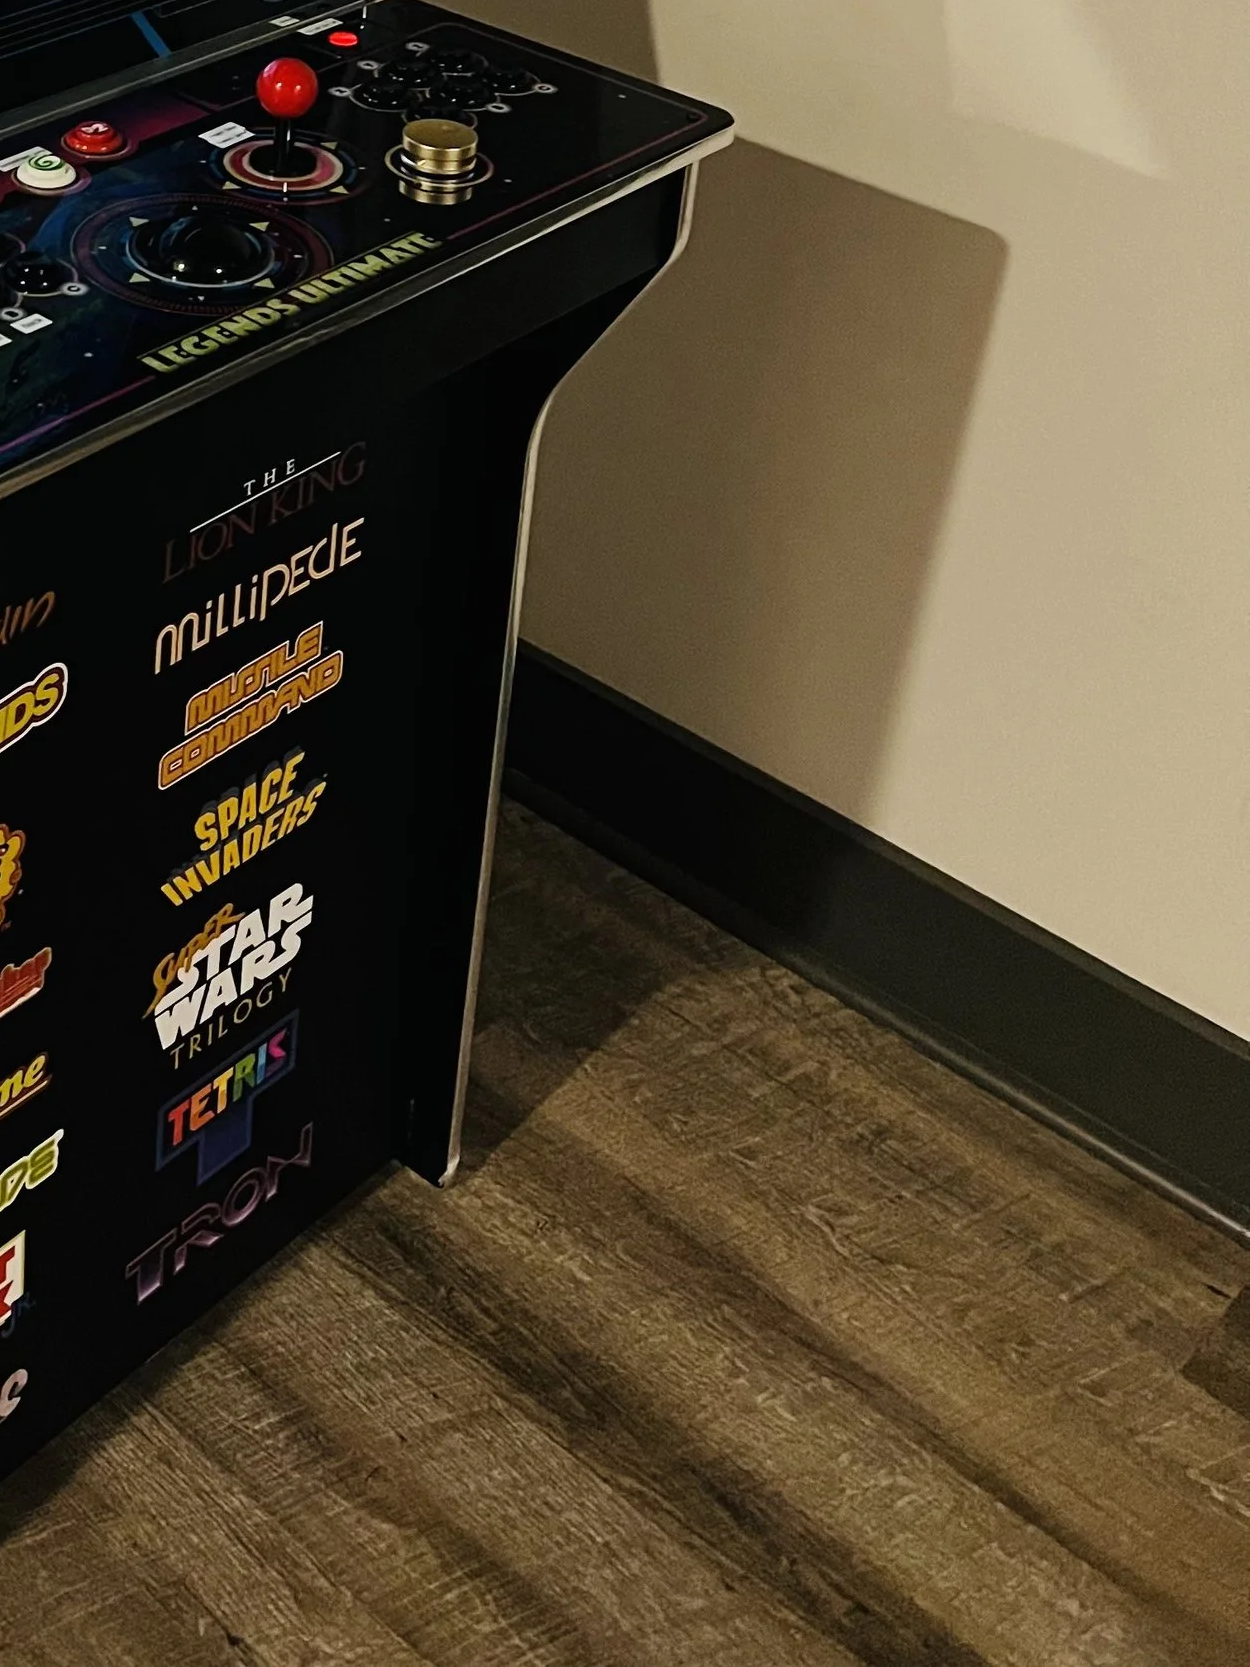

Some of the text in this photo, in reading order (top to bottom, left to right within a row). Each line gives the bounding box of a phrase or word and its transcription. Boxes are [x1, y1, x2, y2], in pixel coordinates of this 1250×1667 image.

[141, 232, 443, 373] LEGENDS ULTIMATE
[162, 441, 368, 584] LION KING
[243, 458, 296, 497] THE
[158, 650, 343, 790] COMMAND
[186, 621, 323, 734] MISSILE
[161, 781, 327, 906] INVADERS
[194, 749, 304, 851] SPACE
[154, 883, 314, 1015] STAR
[155, 911, 313, 1050] WARS
[170, 967, 292, 1070] TRILOGY
[168, 1028, 288, 1147] TETRIS
[125, 1121, 314, 1306] TRON
